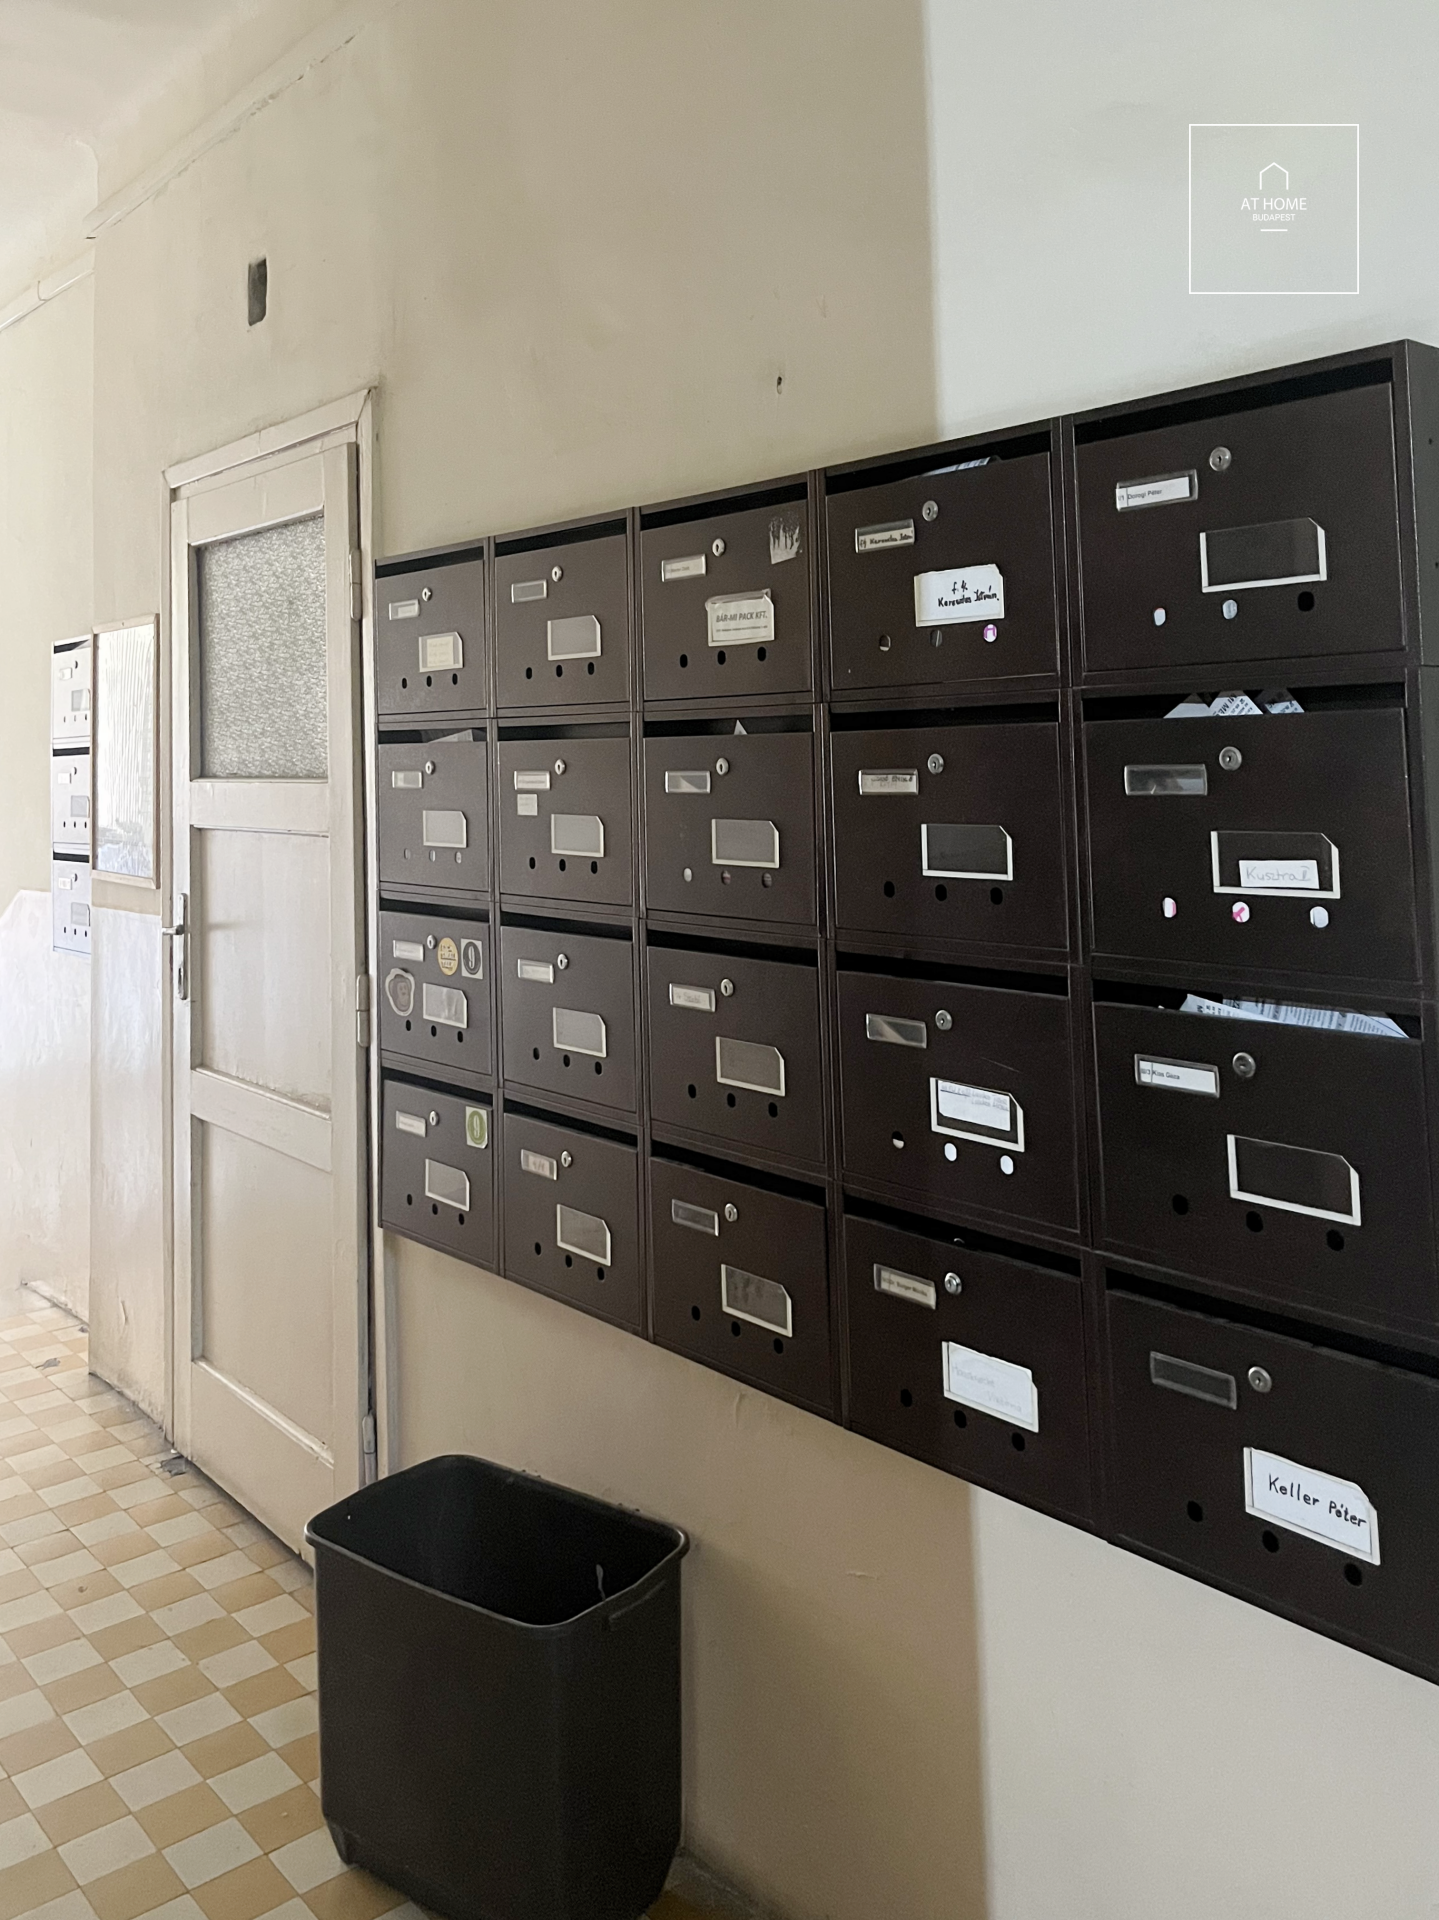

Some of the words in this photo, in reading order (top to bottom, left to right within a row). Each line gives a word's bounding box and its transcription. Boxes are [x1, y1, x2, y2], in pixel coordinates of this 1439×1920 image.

[739, 611, 754, 621] PACK
[468, 945, 476, 969] 9
[473, 1115, 480, 1138] 9
[1269, 1474, 1320, 1505] Keller
[1328, 1500, 1367, 1527] Péter
